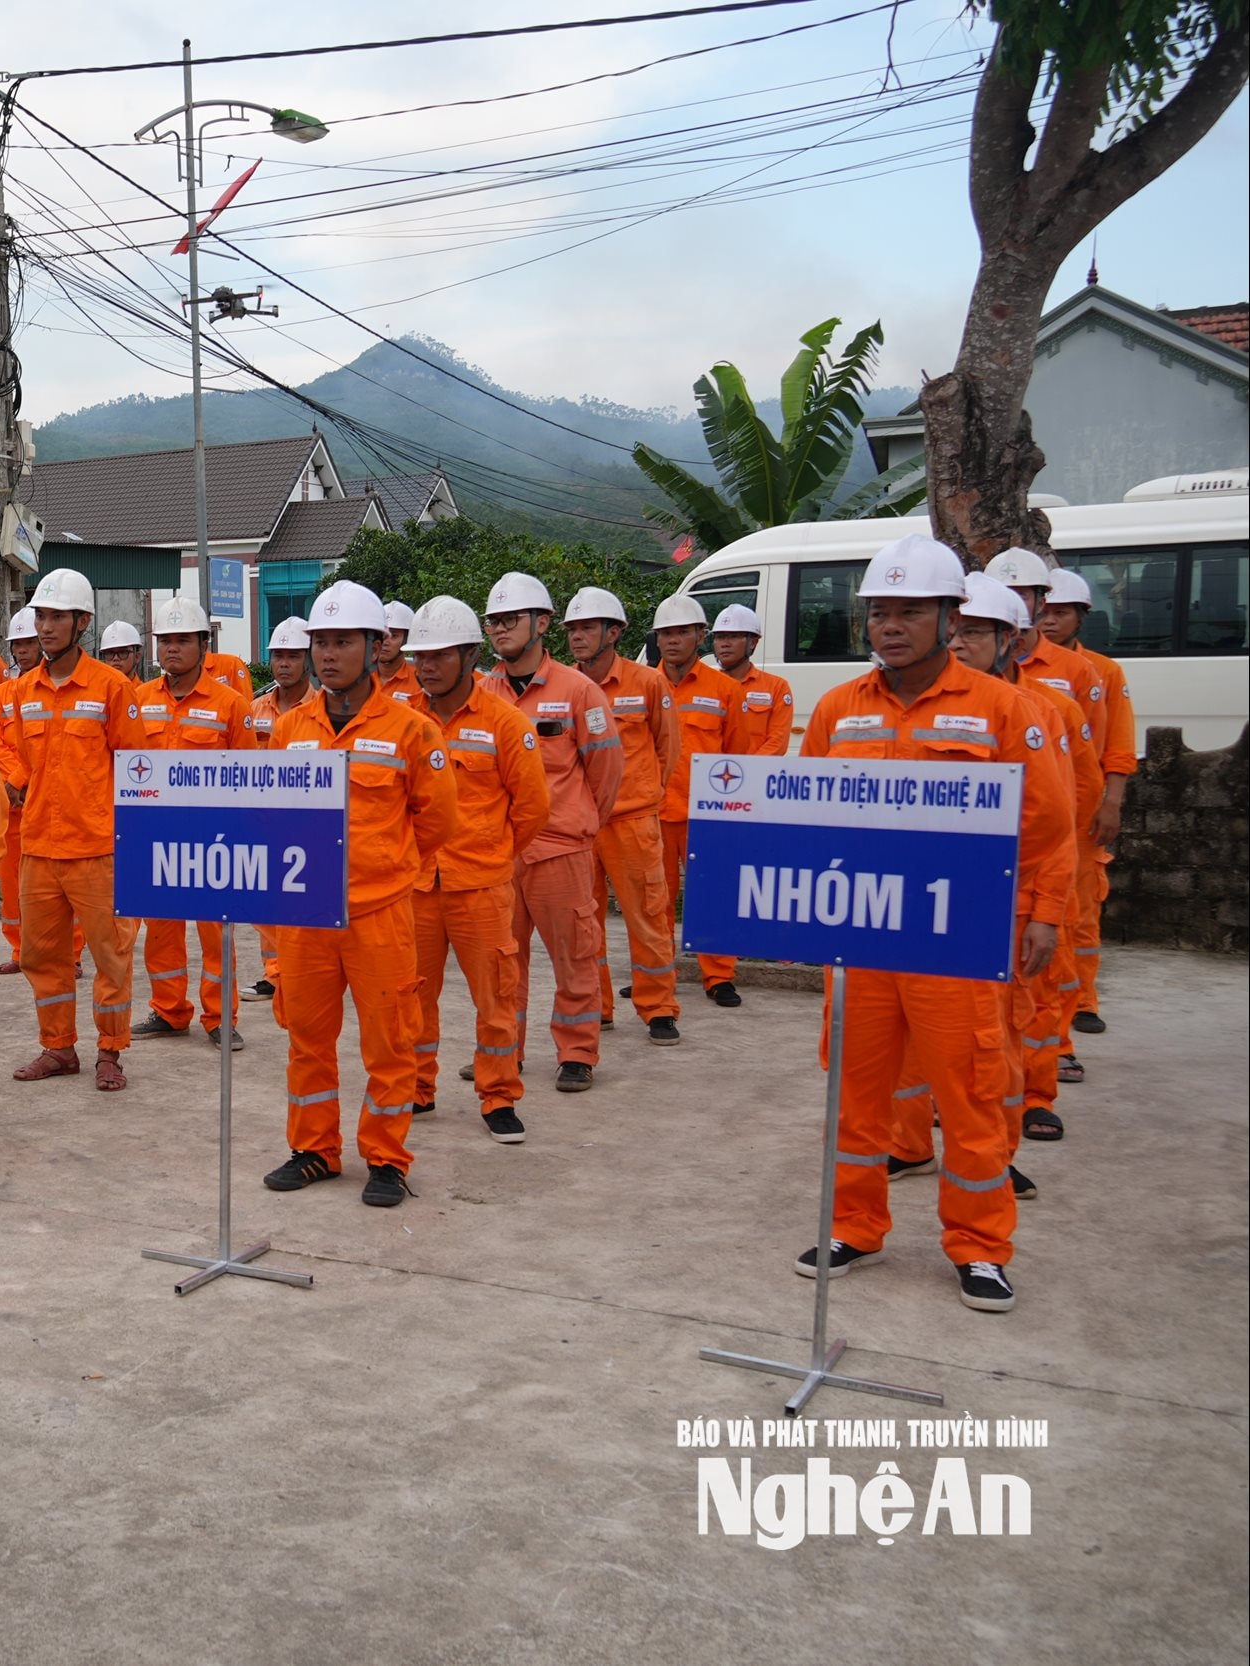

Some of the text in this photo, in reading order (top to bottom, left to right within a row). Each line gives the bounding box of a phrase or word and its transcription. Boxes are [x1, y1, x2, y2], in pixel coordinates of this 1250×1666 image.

[120, 789, 159, 798] EVNNPC
[168, 761, 332, 793] CÔNG TY ĐIỆN LỰC NGHỆ AN
[766, 769, 1001, 813] CÔNG TY ĐIỆN LỰC NGHỆ AN
[697, 800, 752, 813] EVNNPC
[152, 833, 307, 893] NHÓM 2
[737, 858, 950, 935] NHÓM 1
